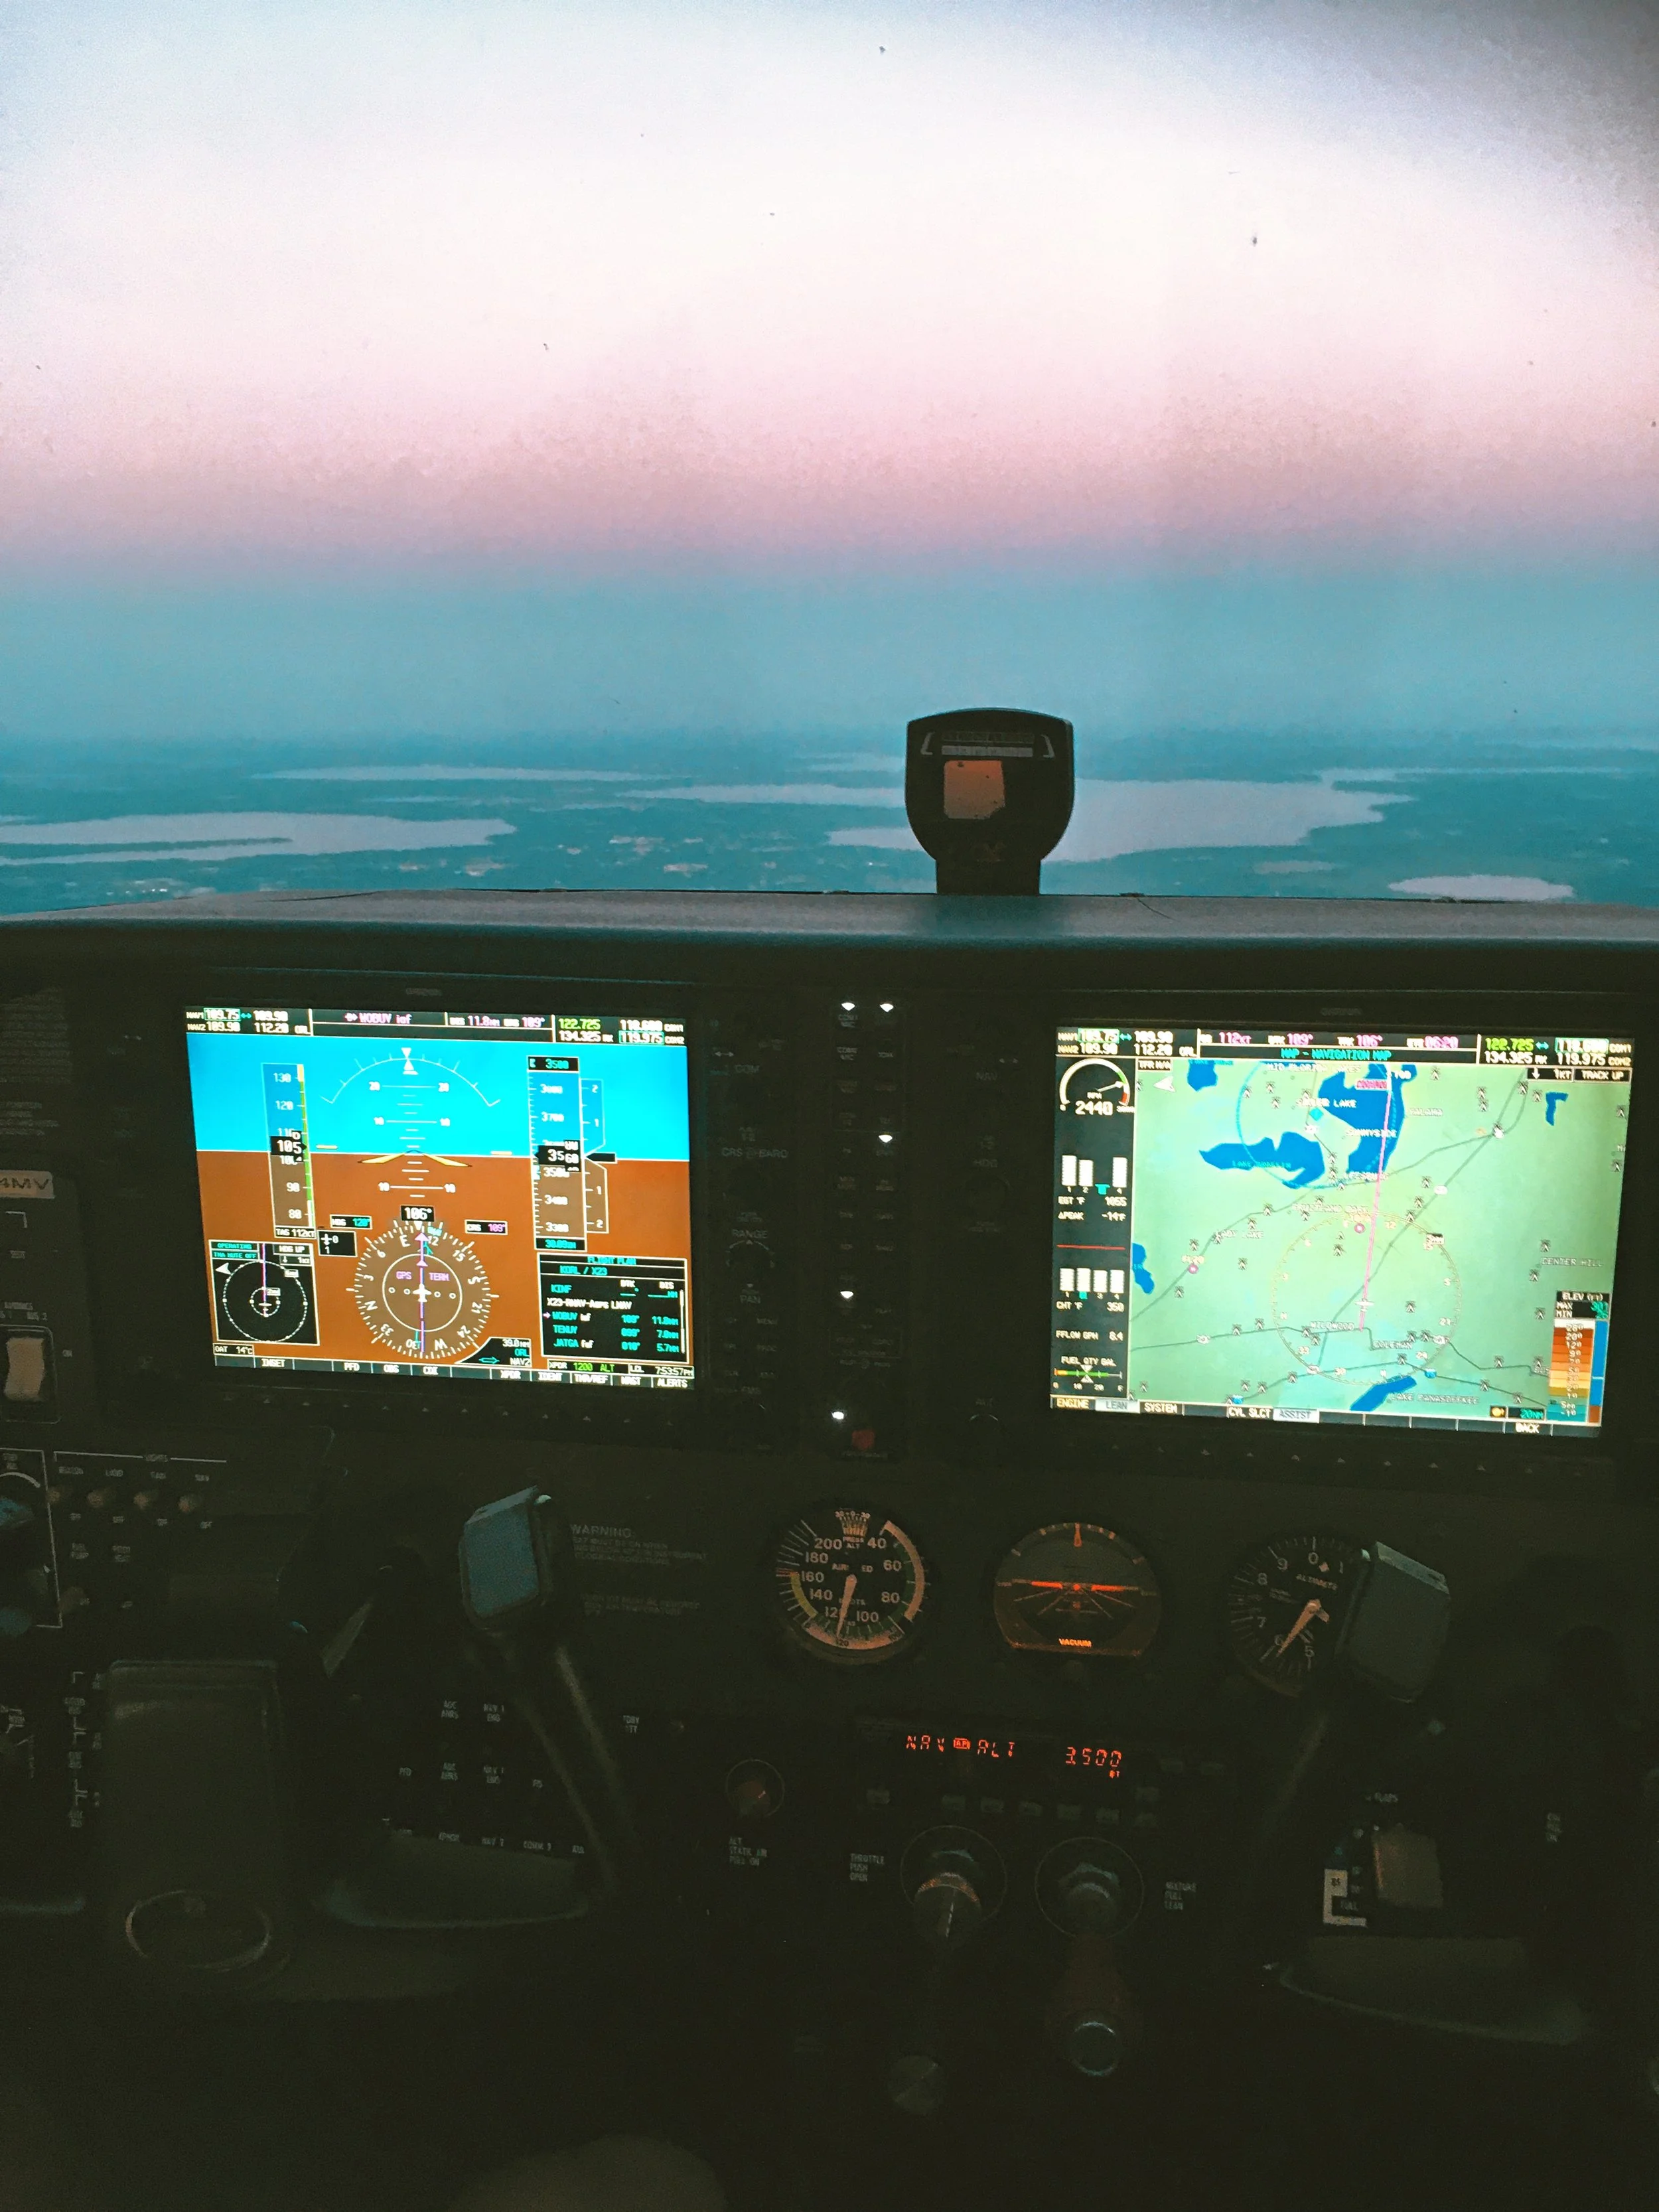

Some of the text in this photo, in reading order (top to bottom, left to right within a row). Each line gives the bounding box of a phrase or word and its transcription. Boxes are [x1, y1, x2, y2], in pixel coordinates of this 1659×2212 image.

[559, 1018, 601, 1030] 122.725
[1485, 1038, 1534, 1051] 122.725
[1312, 1049, 1370, 1061] NAVIGATION
[1557, 1053, 1606, 1065] 119.975
[1581, 1070, 1608, 1079] TRACK
[1611, 1071, 1623, 1080] UP
[1075, 1101, 1113, 1115] 2440
[1333, 1099, 1356, 1108] LAKE
[277, 1140, 302, 1153] 105
[722, 1149, 789, 1159] CRS BARO
[597, 1219, 603, 1228] 2
[399, 1235, 411, 1247] E
[453, 1250, 466, 1262] 15
[1542, 1257, 1577, 1266] CENTER
[429, 1272, 449, 1281] TERM
[1562, 1291, 1584, 1300] ELEV
[471, 1302, 483, 1313] 21
[1557, 1301, 1573, 1309] MAX
[380, 1323, 394, 1336] 33
[457, 1325, 471, 1338] 24
[435, 1338, 447, 1351] W
[1061, 1356, 1081, 1364] FUEL
[573, 1363, 593, 1371] 1200
[600, 1364, 614, 1372] ALT
[261, 1359, 285, 1367] INSET
[344, 1363, 360, 1371] PFD
[657, 1378, 687, 1388] ALERTS
[1056, 1398, 1089, 1409] ENGINE
[1106, 1401, 1127, 1410] LEAN
[1144, 1403, 1177, 1413] SYSTEM
[1248, 1408, 1271, 1418] SLCT
[815, 1538, 887, 1550] 200 40
[806, 1552, 828, 1563] 180
[1277, 1558, 1288, 1571] 9
[1309, 1552, 1319, 1564] 0
[883, 1560, 902, 1571] 60
[802, 1572, 824, 1582] 160
[1258, 1573, 1267, 1585] 8
[810, 1589, 833, 1600] 140
[881, 1592, 899, 1603] 80
[857, 1611, 879, 1622] 100
[1258, 1617, 1266, 1627] 7
[1059, 1638, 1092, 1647] VACUUM
[1305, 1646, 1315, 1658] 5
[906, 1735, 1015, 1757] NAV ALT
[1065, 1747, 1122, 1768] 3500
